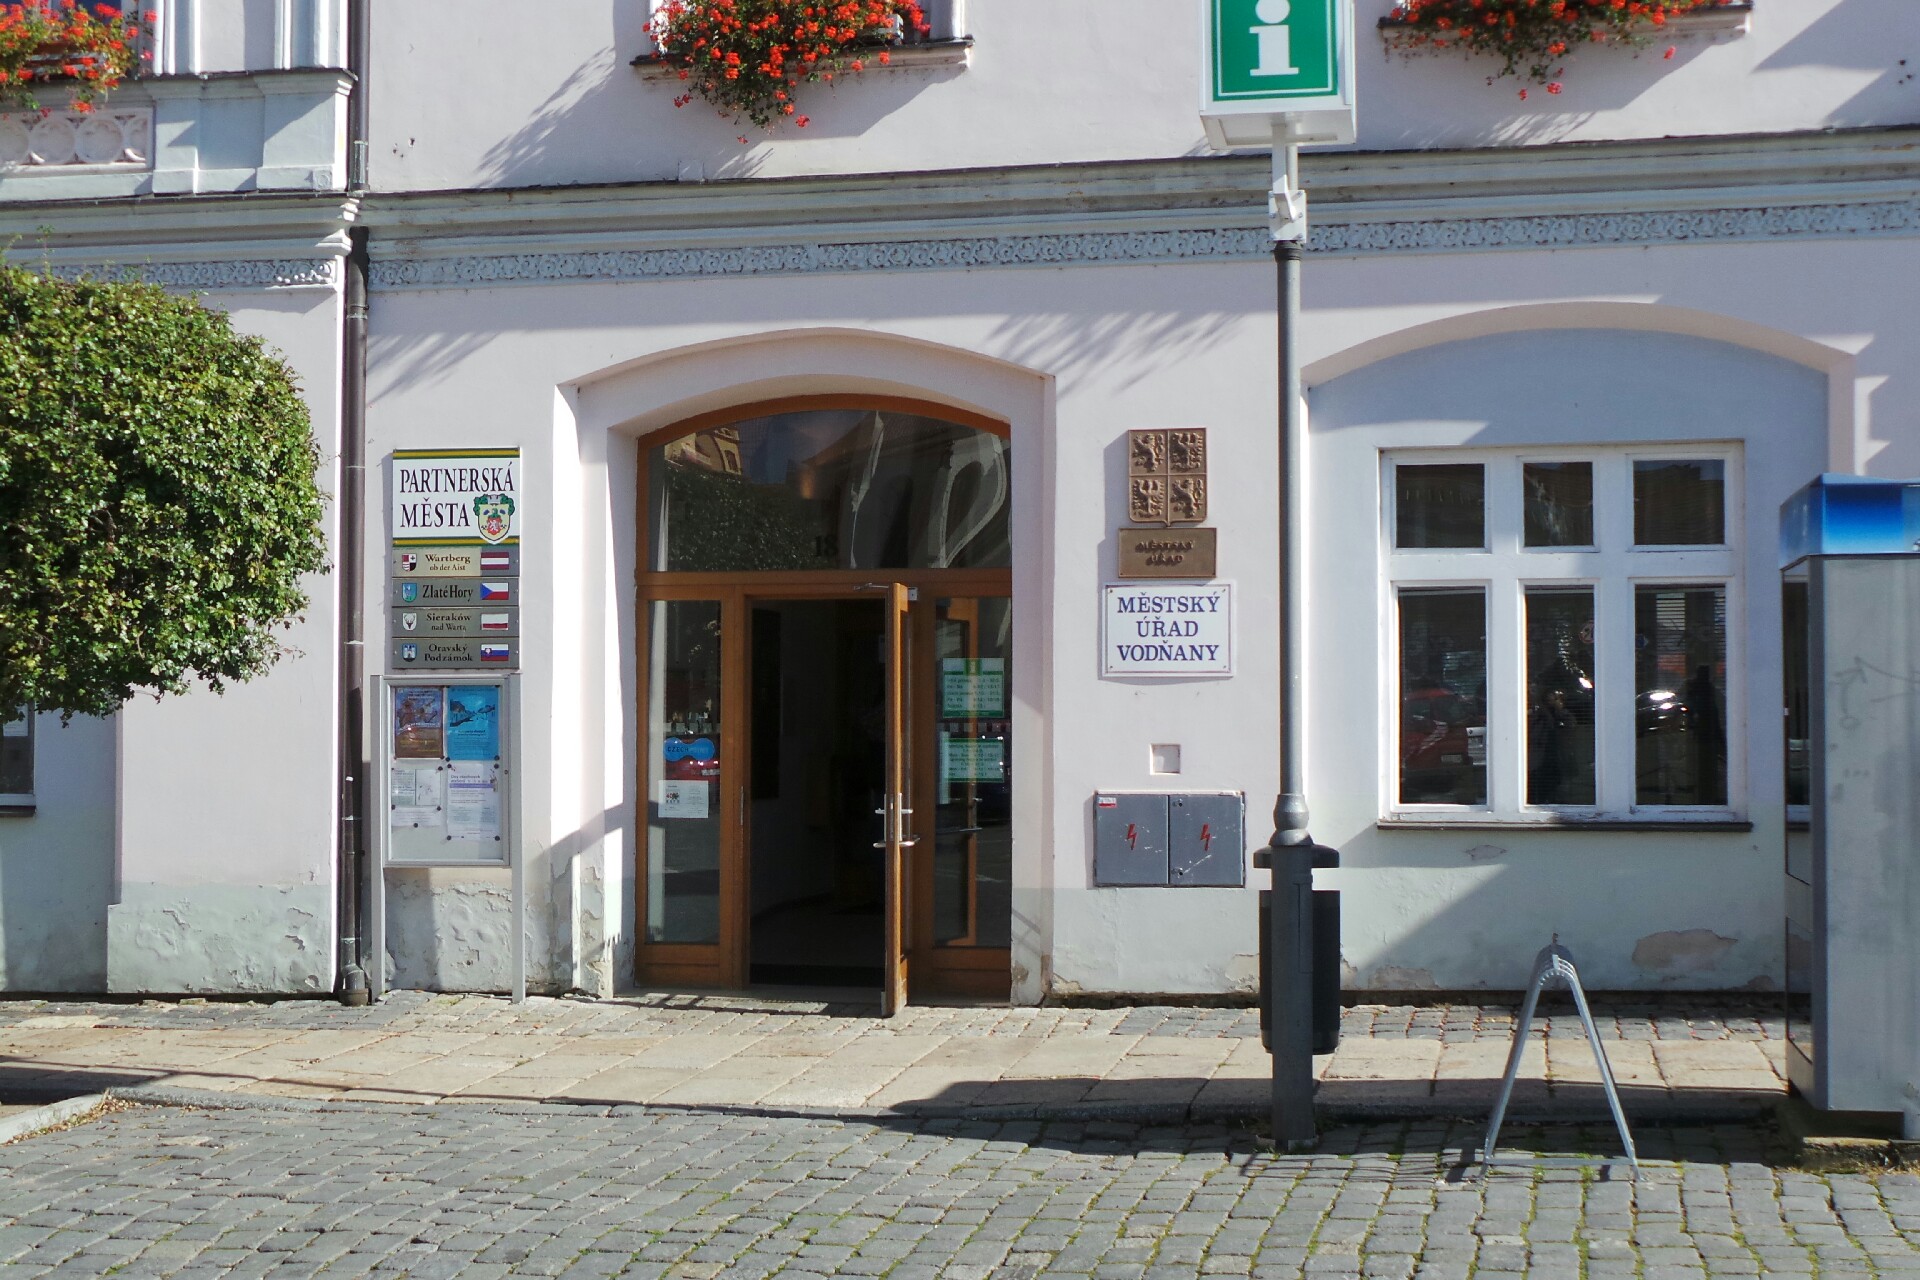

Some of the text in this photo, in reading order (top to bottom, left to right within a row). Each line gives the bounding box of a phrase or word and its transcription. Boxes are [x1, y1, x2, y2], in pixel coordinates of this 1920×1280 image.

[400, 461, 515, 493] PARTNERSKÁ
[400, 497, 471, 528] MĚSTA
[425, 553, 471, 564] Wartberg
[429, 562, 466, 571] ob der Aist
[422, 584, 474, 602] Zlaté Hory
[1117, 591, 1221, 614] MĚSTSKÝ
[426, 612, 472, 621] Sieraków
[431, 623, 444, 631] nad
[1136, 616, 1199, 638] ÚŘAD
[428, 643, 468, 653] Oravský
[1117, 640, 1220, 662] VODŇANY
[424, 653, 473, 662] Podzámok
